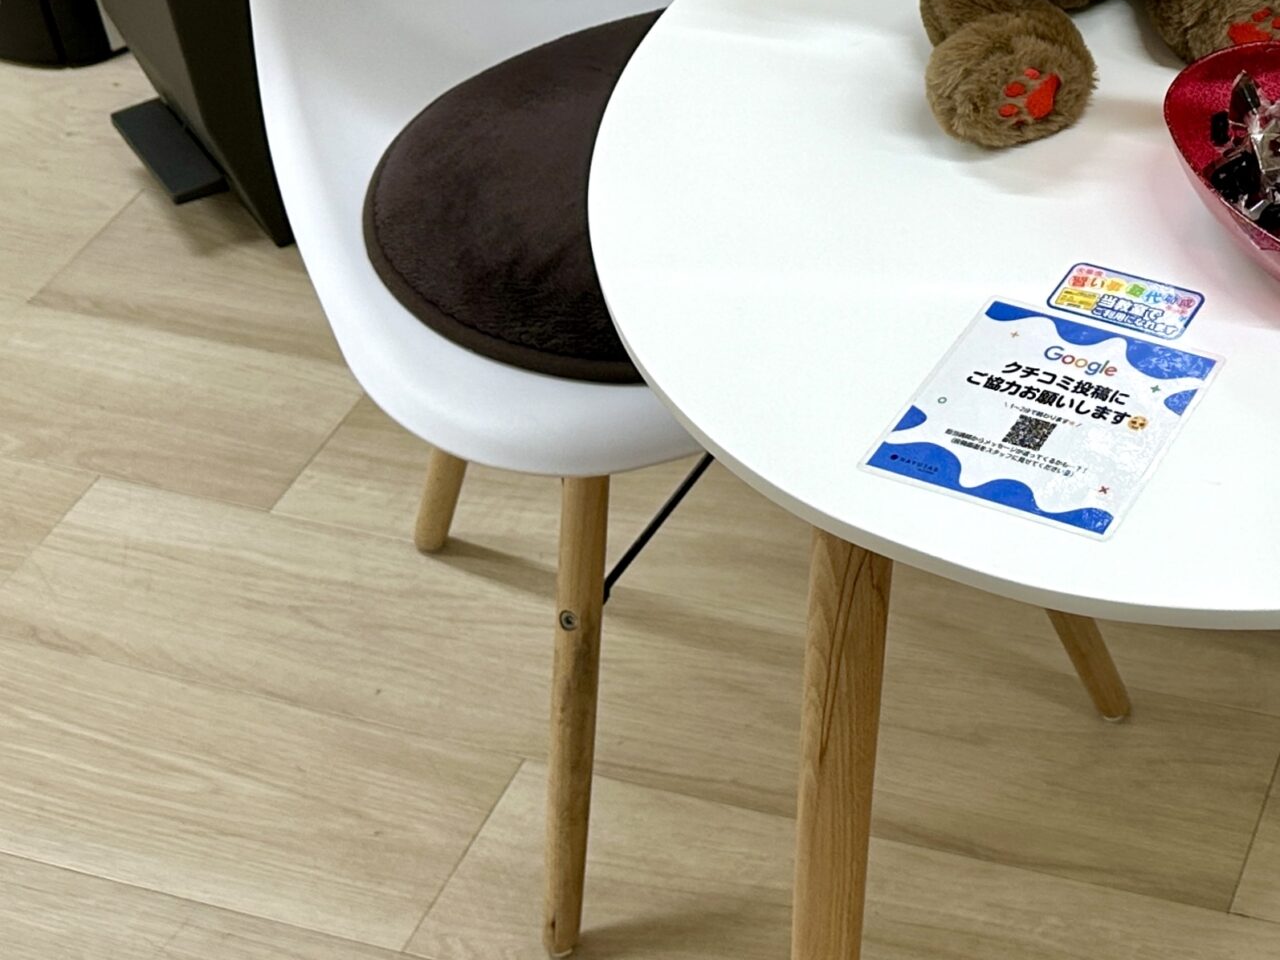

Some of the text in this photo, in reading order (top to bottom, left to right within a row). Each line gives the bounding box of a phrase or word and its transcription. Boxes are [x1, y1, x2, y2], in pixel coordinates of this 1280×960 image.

[1092, 306, 1179, 336] ご利用になれます
[1097, 293, 1165, 321] 当教室で
[1044, 345, 1117, 377] Google
[966, 370, 1133, 425] ご協力お願いします
[1001, 361, 1130, 407] クチコミ投稿に
